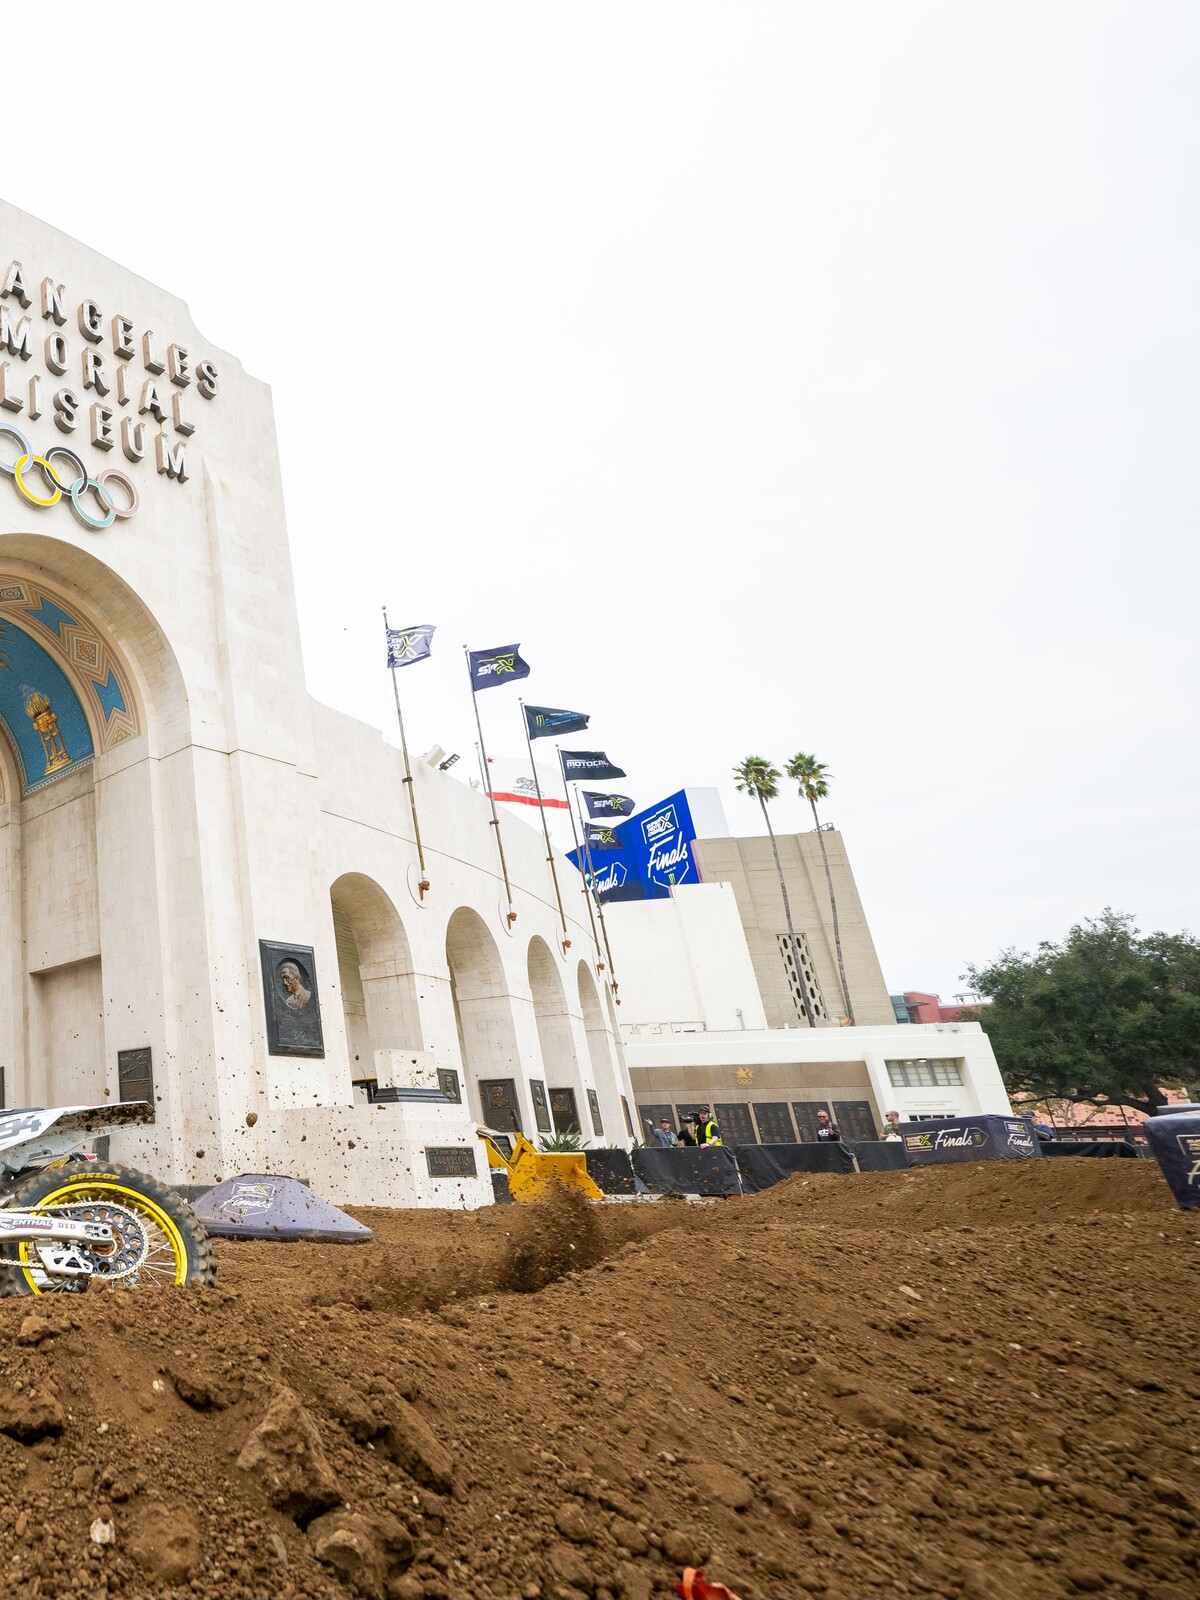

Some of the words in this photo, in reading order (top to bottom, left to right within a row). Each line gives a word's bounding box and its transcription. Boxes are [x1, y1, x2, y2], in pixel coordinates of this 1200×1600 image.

[0, 260, 220, 400] ANGELES
[593, 797, 627, 811] SMX
[647, 831, 688, 878] Finals
[934, 1128, 973, 1150] Finals
[1007, 1133, 1034, 1147] Finals
[66, 1172, 121, 1182] DUNLOP
